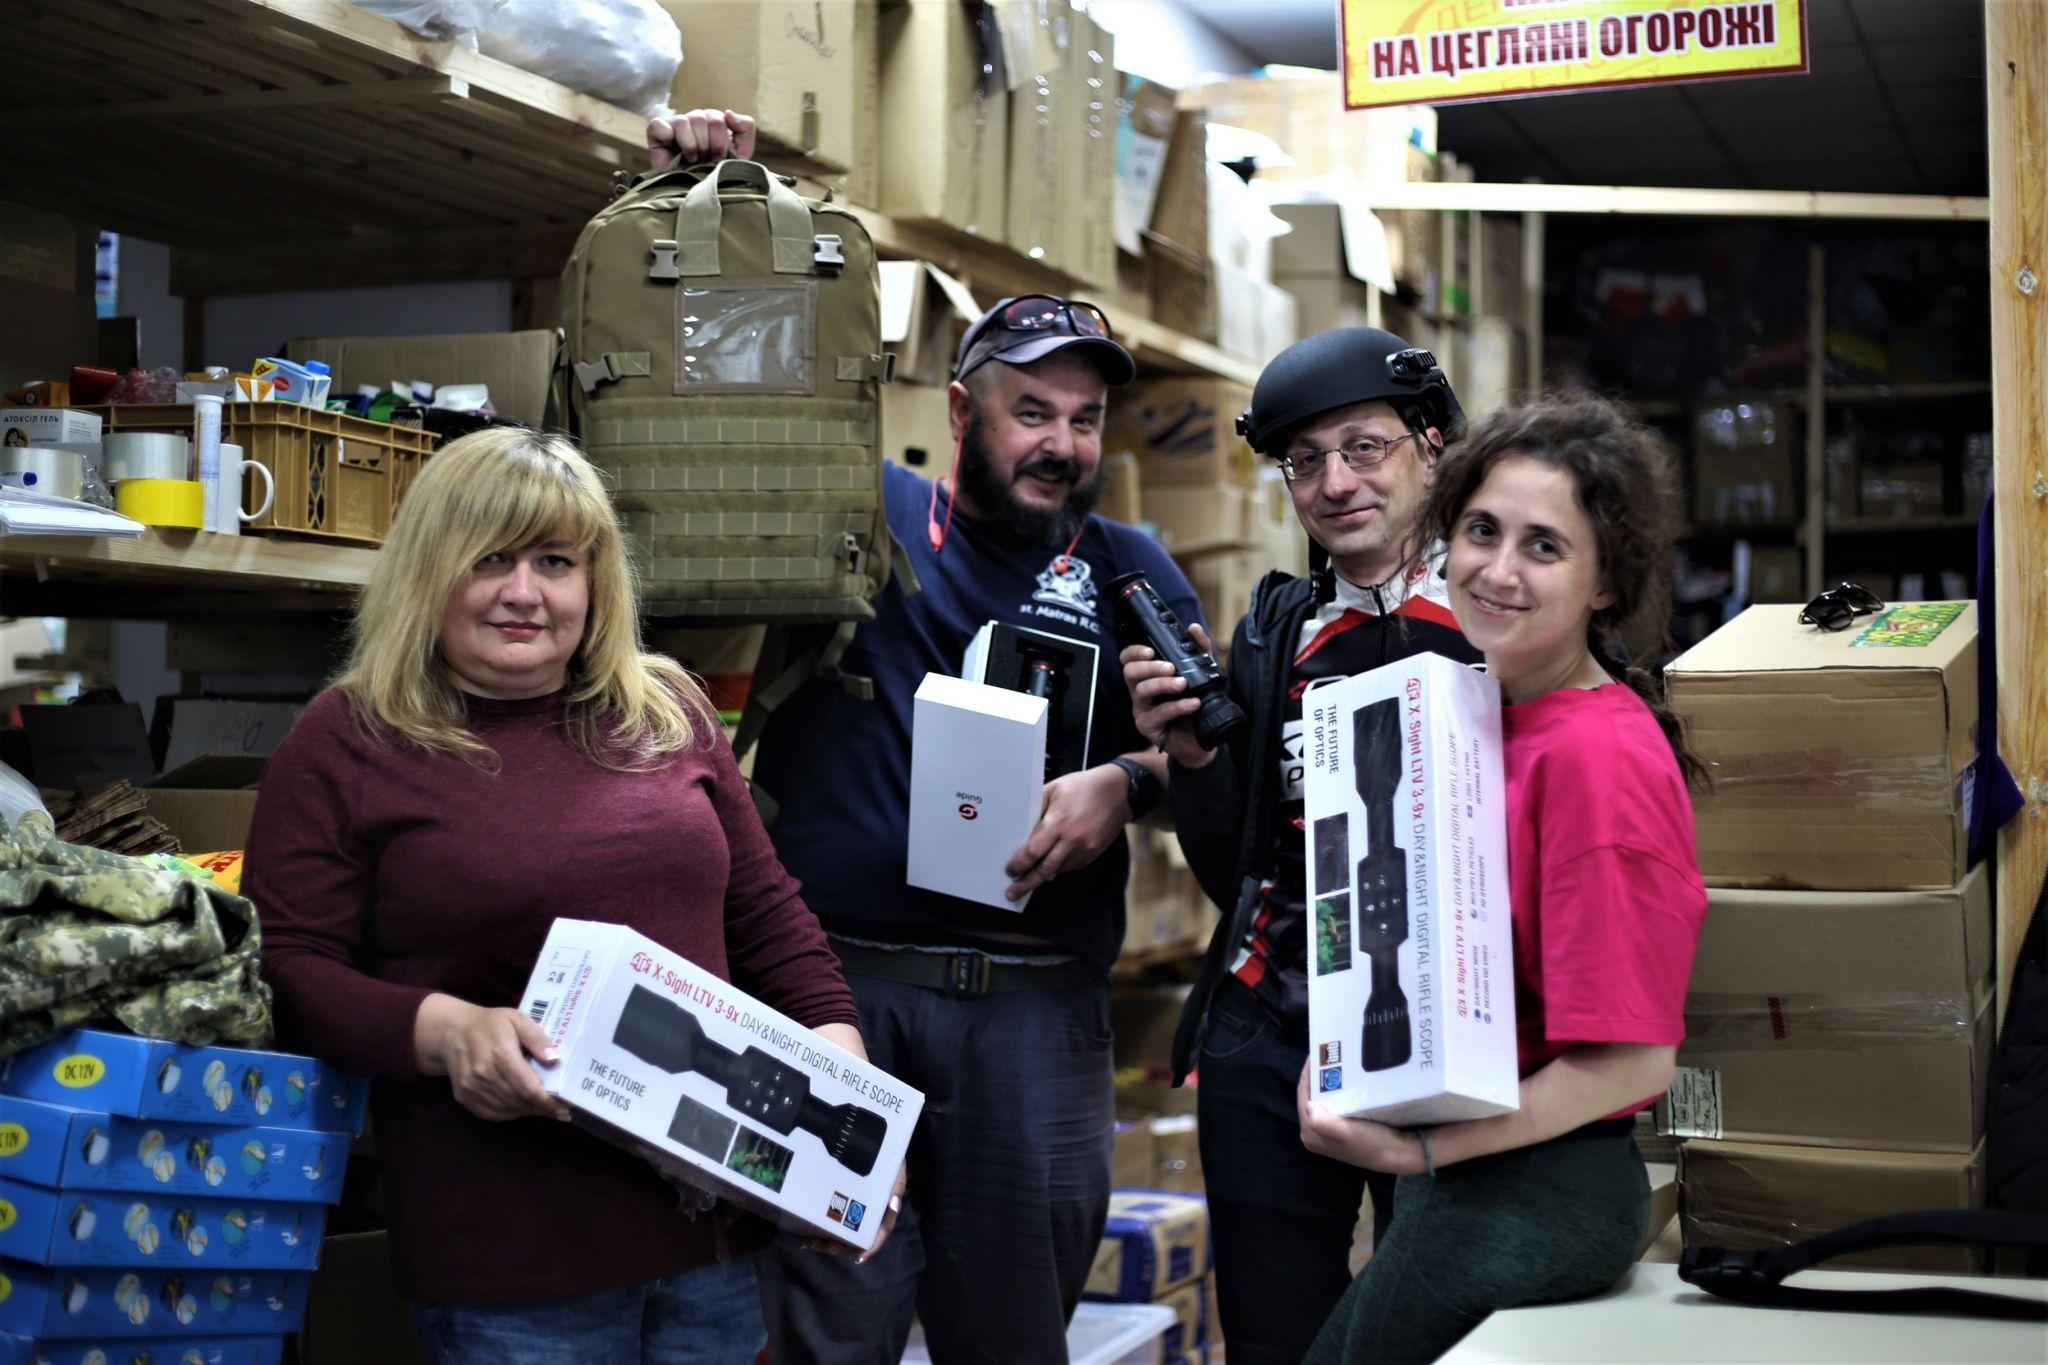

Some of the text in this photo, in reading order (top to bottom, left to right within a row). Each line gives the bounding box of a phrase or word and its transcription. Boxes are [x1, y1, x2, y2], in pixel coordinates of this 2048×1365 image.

[1373, 38, 1420, 78] НА
[1430, 20, 1588, 77] ЦЕГЛЯНІ
[1599, 3, 1775, 57] ОГОРОЖІ
[4, 415, 59, 423] АТОКСІЛ ГЕЛЬ
[1313, 708, 1325, 768] OF OPTICS
[1328, 703, 1339, 775] THE FUTURE
[1408, 707, 1422, 757] X-Sight
[1448, 731, 1457, 767] SCOPE
[1411, 758, 1424, 784] LTV
[1449, 769, 1458, 798] RIFLE
[955, 791, 983, 804] Guide
[1412, 788, 1424, 821] 3-9x
[1451, 803, 1460, 841] DIGITAL
[1413, 823, 1428, 907] DAY&NIGHT
[1452, 844, 1463, 906] DAY&NIGHT
[1415, 912, 1430, 969] DIGITAL
[1455, 934, 1464, 955] LTV
[1418, 973, 1432, 1015] RIFLE
[652, 963, 693, 995] X-Sight
[693, 986, 715, 1008] LTV
[715, 999, 740, 1023] 3-9x
[740, 1012, 802, 1057] DAY&NIGHT
[802, 1047, 838, 1080] DIGITAL
[841, 1068, 869, 1096] RIFLE
[869, 1085, 904, 1114] SCOPE
[1419, 1018, 1433, 1070] SCOPE
[64, 1063, 95, 1080] DC 12V
[589, 1058, 647, 1098] THE FUTURE
[581, 1077, 631, 1111] OF OPTICS
